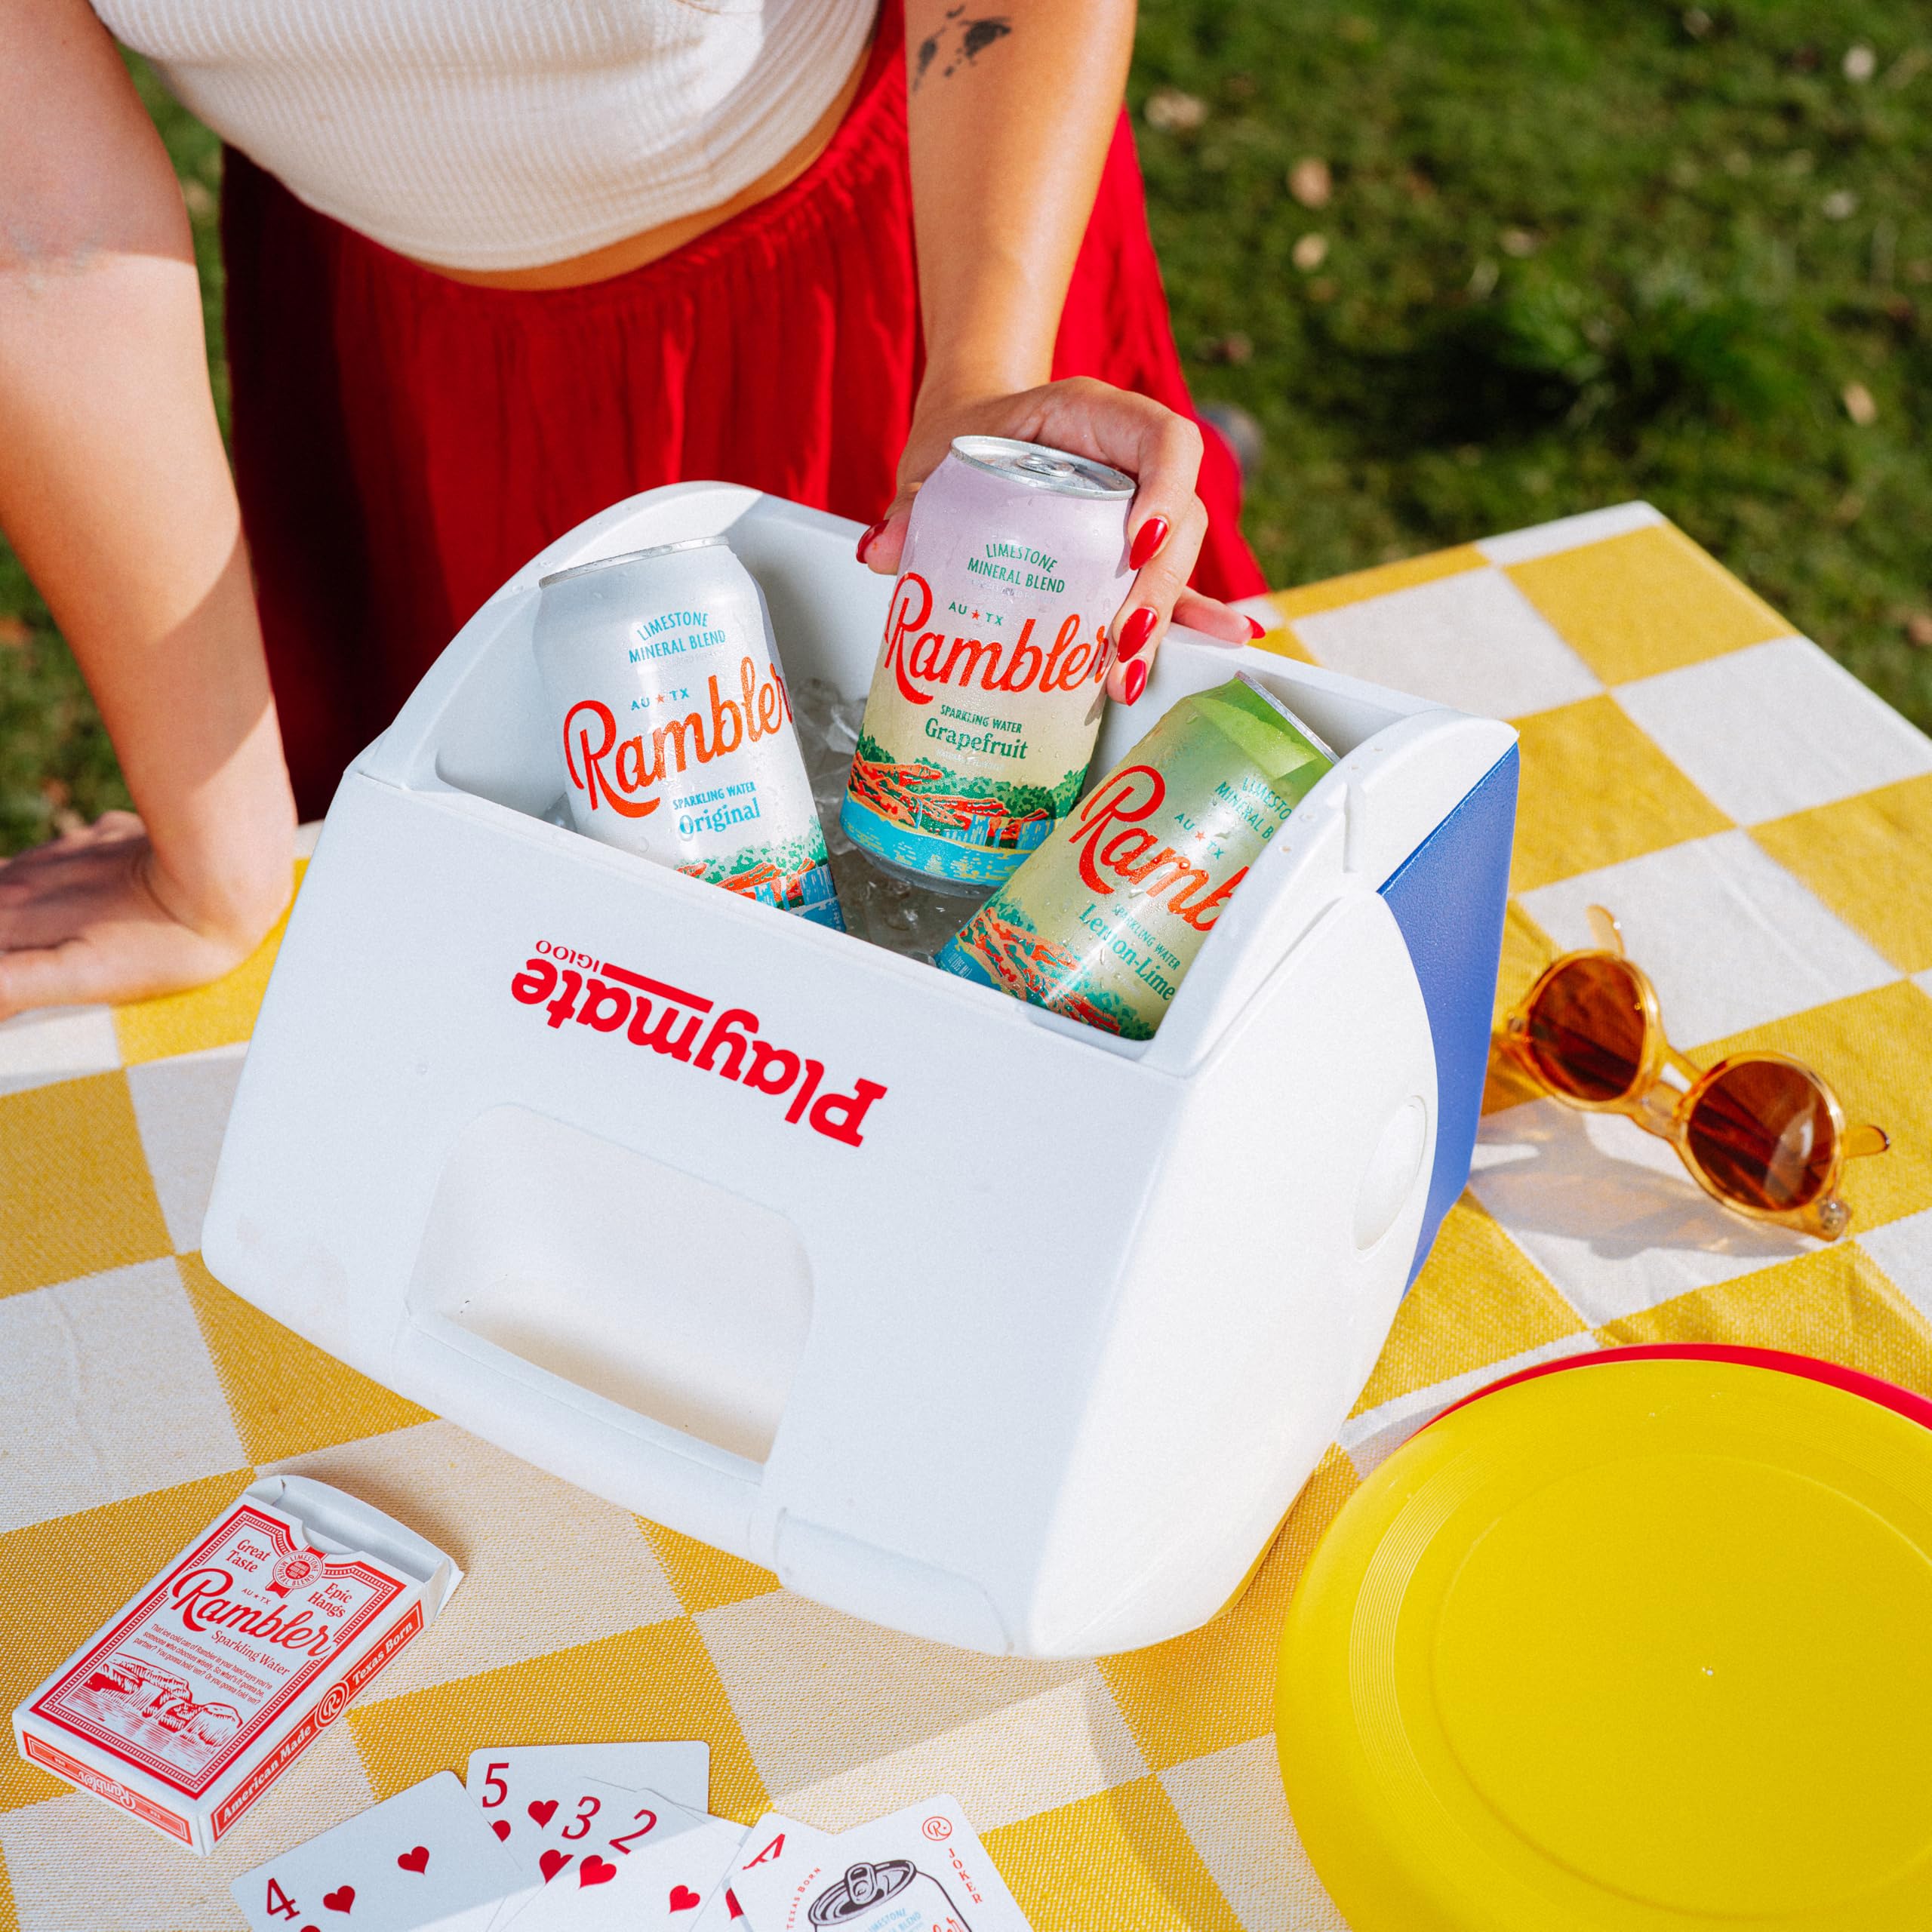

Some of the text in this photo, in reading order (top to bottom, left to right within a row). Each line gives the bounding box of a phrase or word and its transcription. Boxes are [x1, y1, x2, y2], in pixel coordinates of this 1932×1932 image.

[968, 557, 1022, 587] MINERAL
[1026, 573, 1065, 593] BLEND
[986, 543, 1057, 573] LIMESTONE
[637, 611, 708, 641] LIMESTONE
[948, 601, 1004, 626] AU TX
[629, 639, 687, 663] MINERAL
[688, 629, 726, 651] BLEND
[884, 572, 1112, 705] Rambler
[630, 688, 689, 711] AU TX
[940, 704, 1022, 734] SPARKLING WATER
[564, 656, 793, 817] Rambler
[925, 718, 1028, 760] Grapefruit
[673, 782, 755, 810] SPARKLING WATER
[680, 798, 760, 835] Original
[1215, 781, 1264, 832] MINERAL
[1243, 777, 1293, 821] LIMESTO
[1069, 764, 1251, 931] Ramb
[1174, 814, 1225, 860] AU TX
[536, 940, 601, 972] IGLOO
[1078, 904, 1176, 1001] Lemon-Lime
[1112, 903, 1180, 971] SPARKLING WATER
[511, 958, 888, 1148] Playmate
[226, 1549, 258, 1573] Taste
[237, 1539, 271, 1563] Great
[290, 1555, 318, 1571] LIMESTONE
[242, 1586, 271, 1605] AU TX
[277, 1561, 289, 1585] MINERAL
[292, 1574, 315, 1586] BLEND
[325, 1583, 353, 1604] Epic
[171, 1567, 332, 1659] Rambler
[306, 1592, 346, 1619] Hangs
[133, 1638, 157, 1651] partner?
[157, 1647, 168, 1657] You
[165, 1654, 182, 1665] gonna
[180, 1661, 195, 1670] hold
[220, 1682, 237, 1694] gonna
[235, 1690, 248, 1699] fold
[143, 1632, 166, 1645] someone
[165, 1643, 177, 1651] who
[176, 1648, 197, 1661] chooses
[196, 1659, 213, 1670] wisely.
[220, 1672, 238, 1682] what's
[239, 1682, 257, 1693] gonna
[152, 1624, 164, 1633] That
[170, 1634, 183, 1643] cold
[195, 1647, 217, 1660] Rambler
[220, 1660, 233, 1669] your
[232, 1665, 247, 1675] hand
[243, 1672, 257, 1681] says
[254, 1678, 272, 1690] you're
[212, 1629, 291, 1676] Sparkling Water
[352, 1623, 414, 1686] Texas Born
[78, 1771, 136, 1810] Rambler
[223, 1725, 312, 1821] American Made
[481, 1762, 509, 1808] 5
[561, 1795, 601, 1840] 3
[608, 1808, 657, 1855] 2
[742, 1833, 786, 1870] A
[949, 1847, 983, 1904] JOKER
[266, 1877, 301, 1921] 4
[786, 1867, 821, 1930] TEXAS BORN
